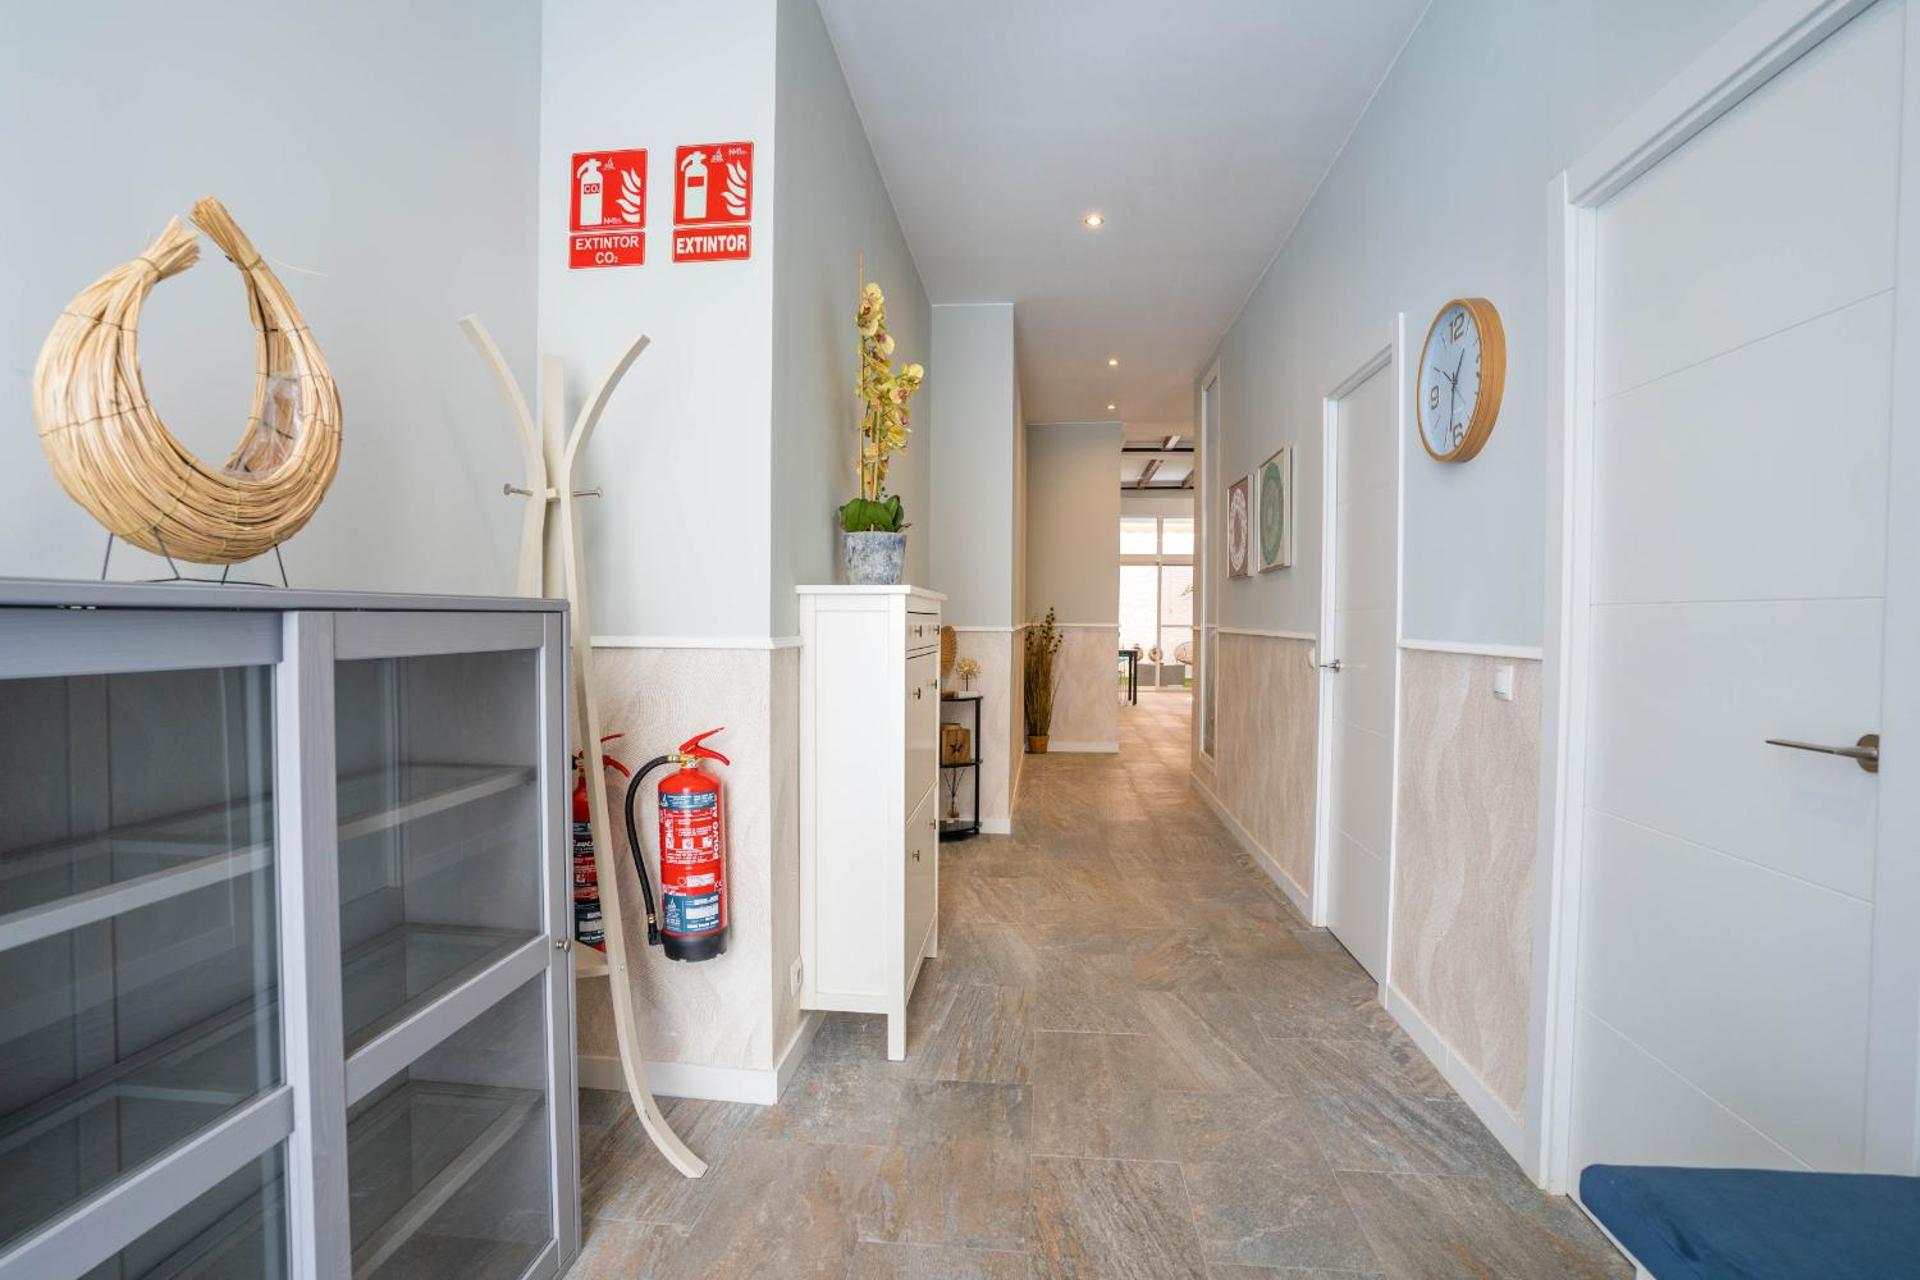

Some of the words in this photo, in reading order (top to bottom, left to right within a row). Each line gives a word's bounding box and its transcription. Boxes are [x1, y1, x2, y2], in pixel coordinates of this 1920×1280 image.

[575, 235, 639, 251] EXTINTOR
[676, 235, 747, 254] EXTINTOR
[1448, 313, 1465, 345] 12
[1430, 385, 1440, 411] 9
